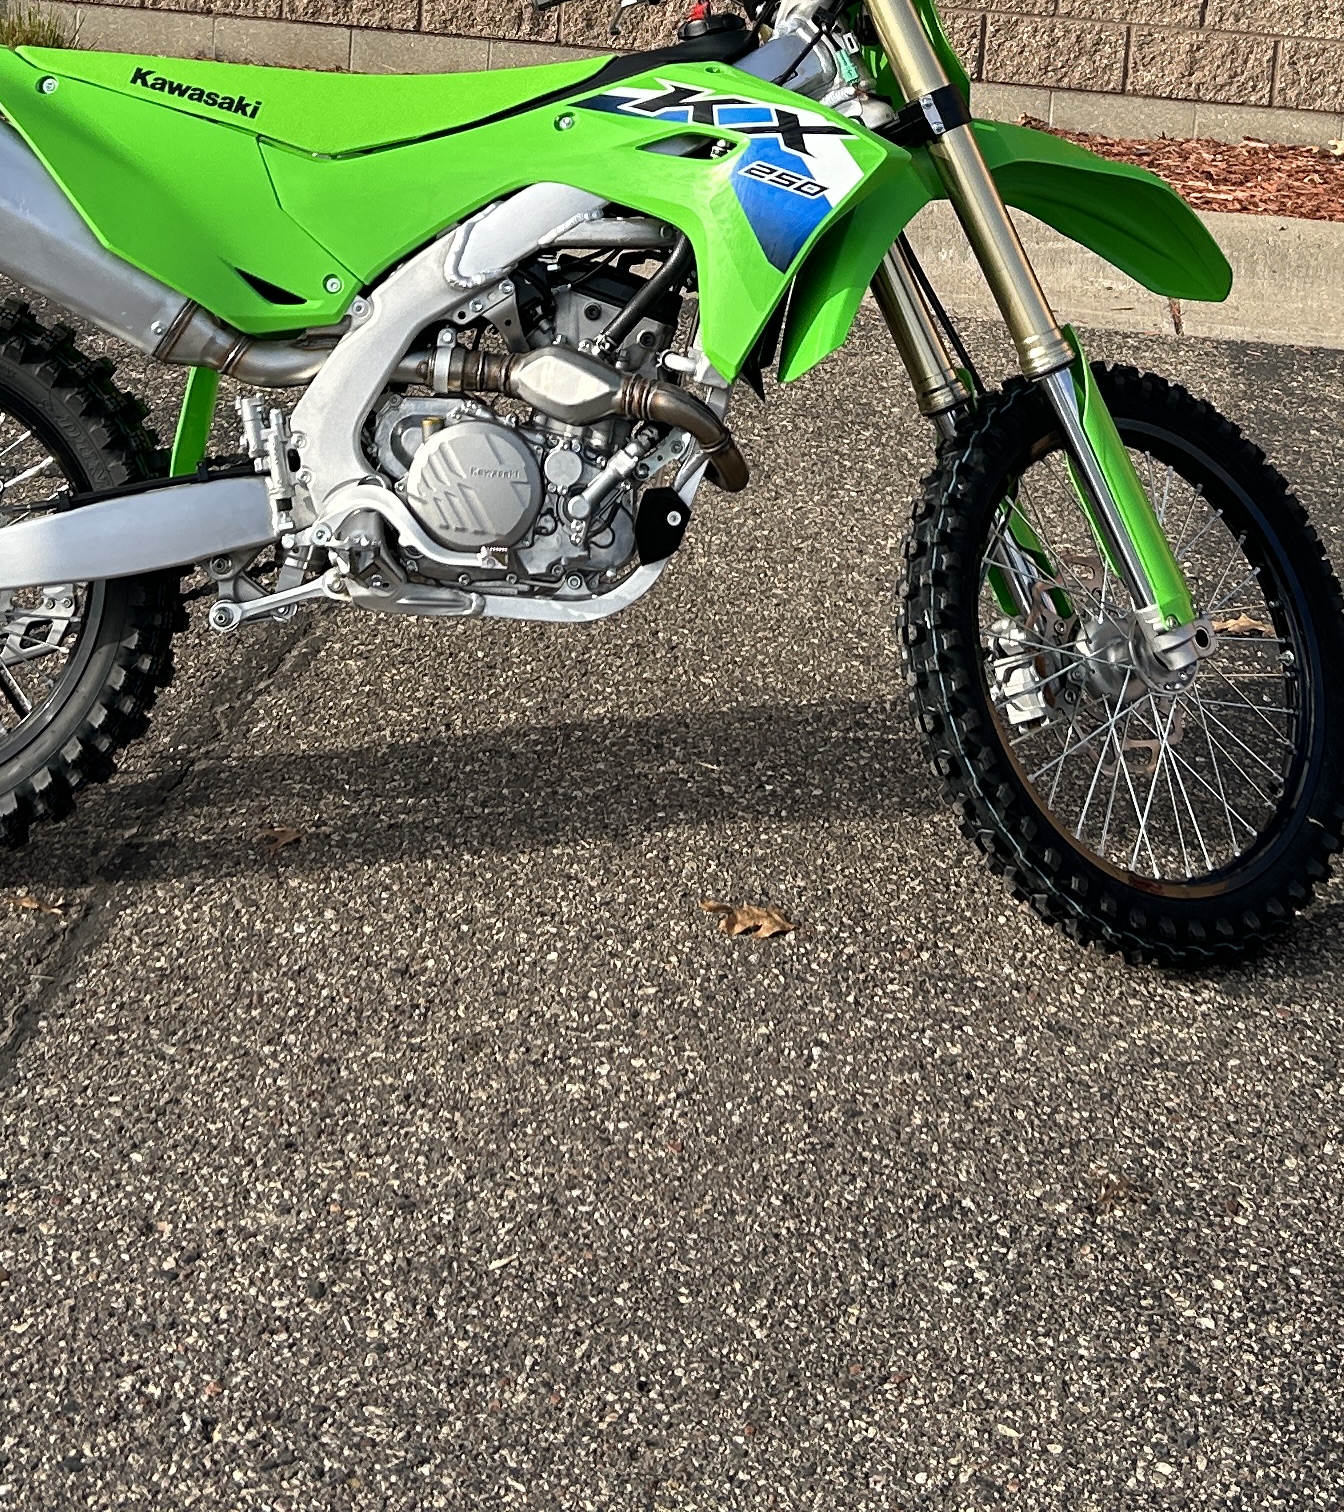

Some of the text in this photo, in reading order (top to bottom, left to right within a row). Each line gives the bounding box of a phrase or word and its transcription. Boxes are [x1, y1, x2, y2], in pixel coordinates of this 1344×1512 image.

[130, 66, 263, 120] Kawasaki
[622, 83, 858, 158] KX
[739, 161, 830, 198] 250
[470, 466, 521, 479] Kawasaki
